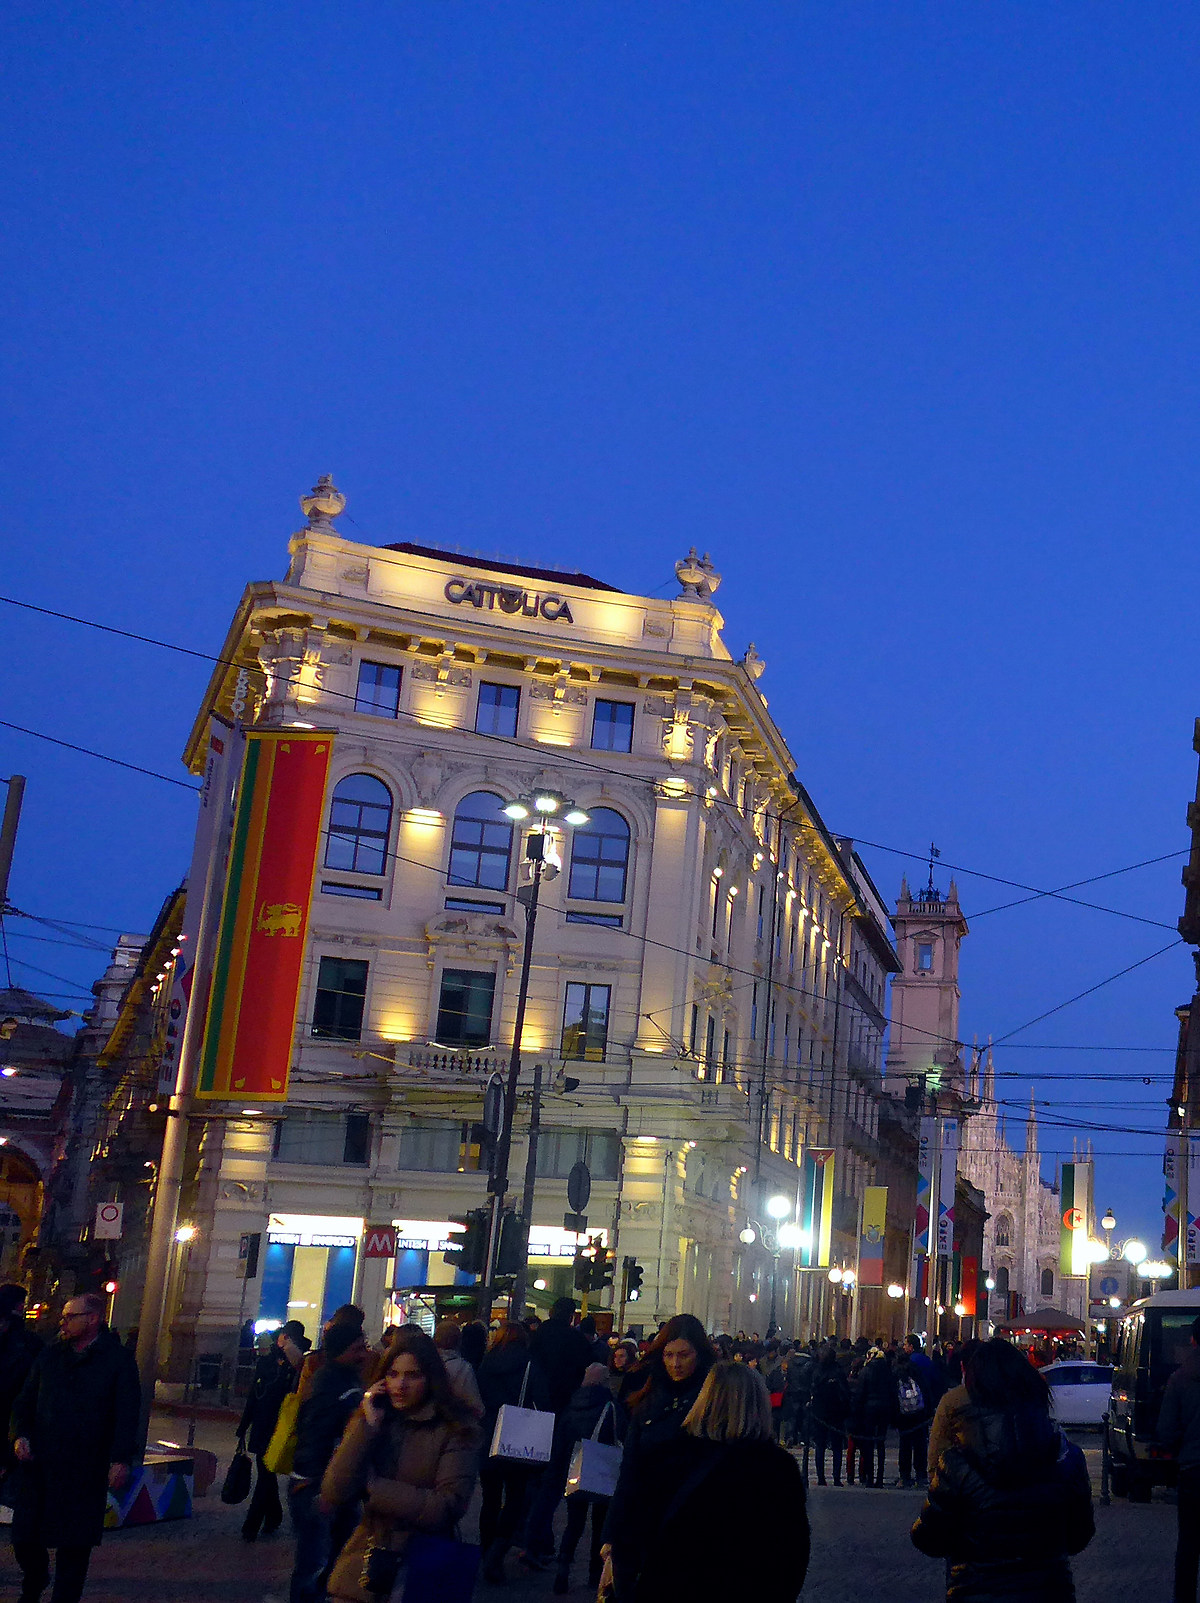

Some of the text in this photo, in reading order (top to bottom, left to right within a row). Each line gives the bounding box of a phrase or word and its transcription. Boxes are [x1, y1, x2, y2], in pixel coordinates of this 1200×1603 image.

[444, 579, 574, 624] CATTOLICA
[939, 1219, 948, 1250] EXPO
[1187, 1229, 1196, 1260] EXPO
